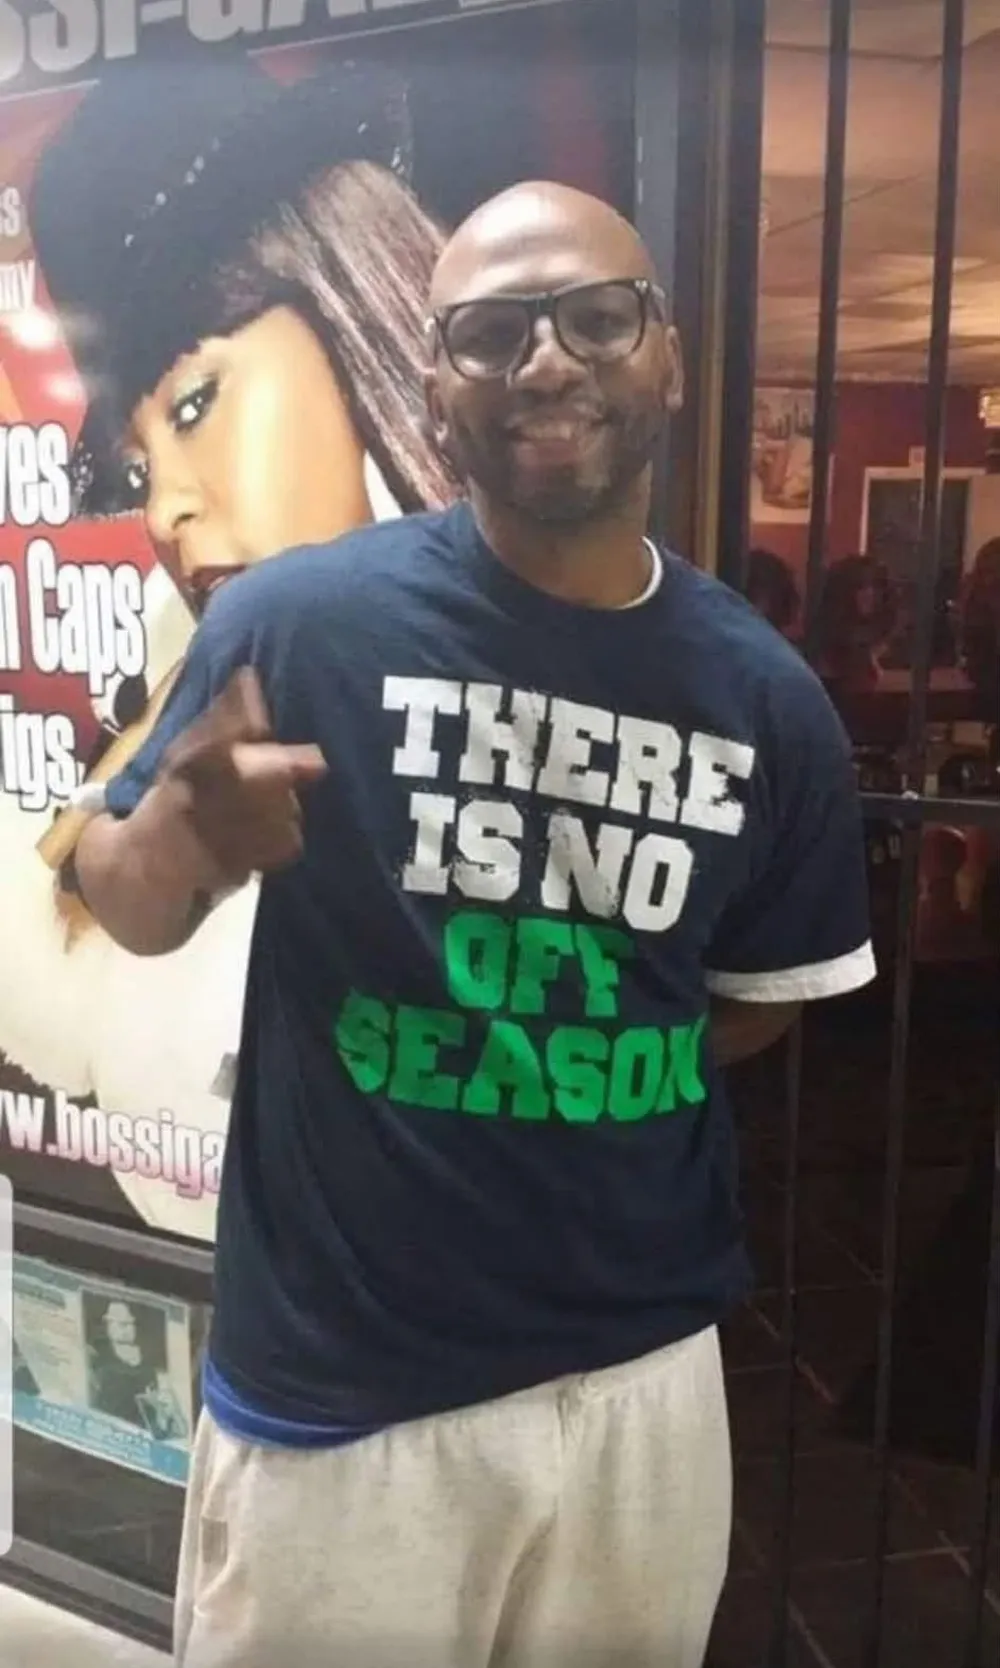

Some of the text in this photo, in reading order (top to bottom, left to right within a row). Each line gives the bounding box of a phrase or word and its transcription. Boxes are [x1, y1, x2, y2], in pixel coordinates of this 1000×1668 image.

[26, 537, 146, 697] Caps
[382, 675, 756, 836] THERE
[400, 791, 695, 933] IS NO
[443, 911, 635, 1018] OFF
[334, 990, 709, 1125] SEASON
